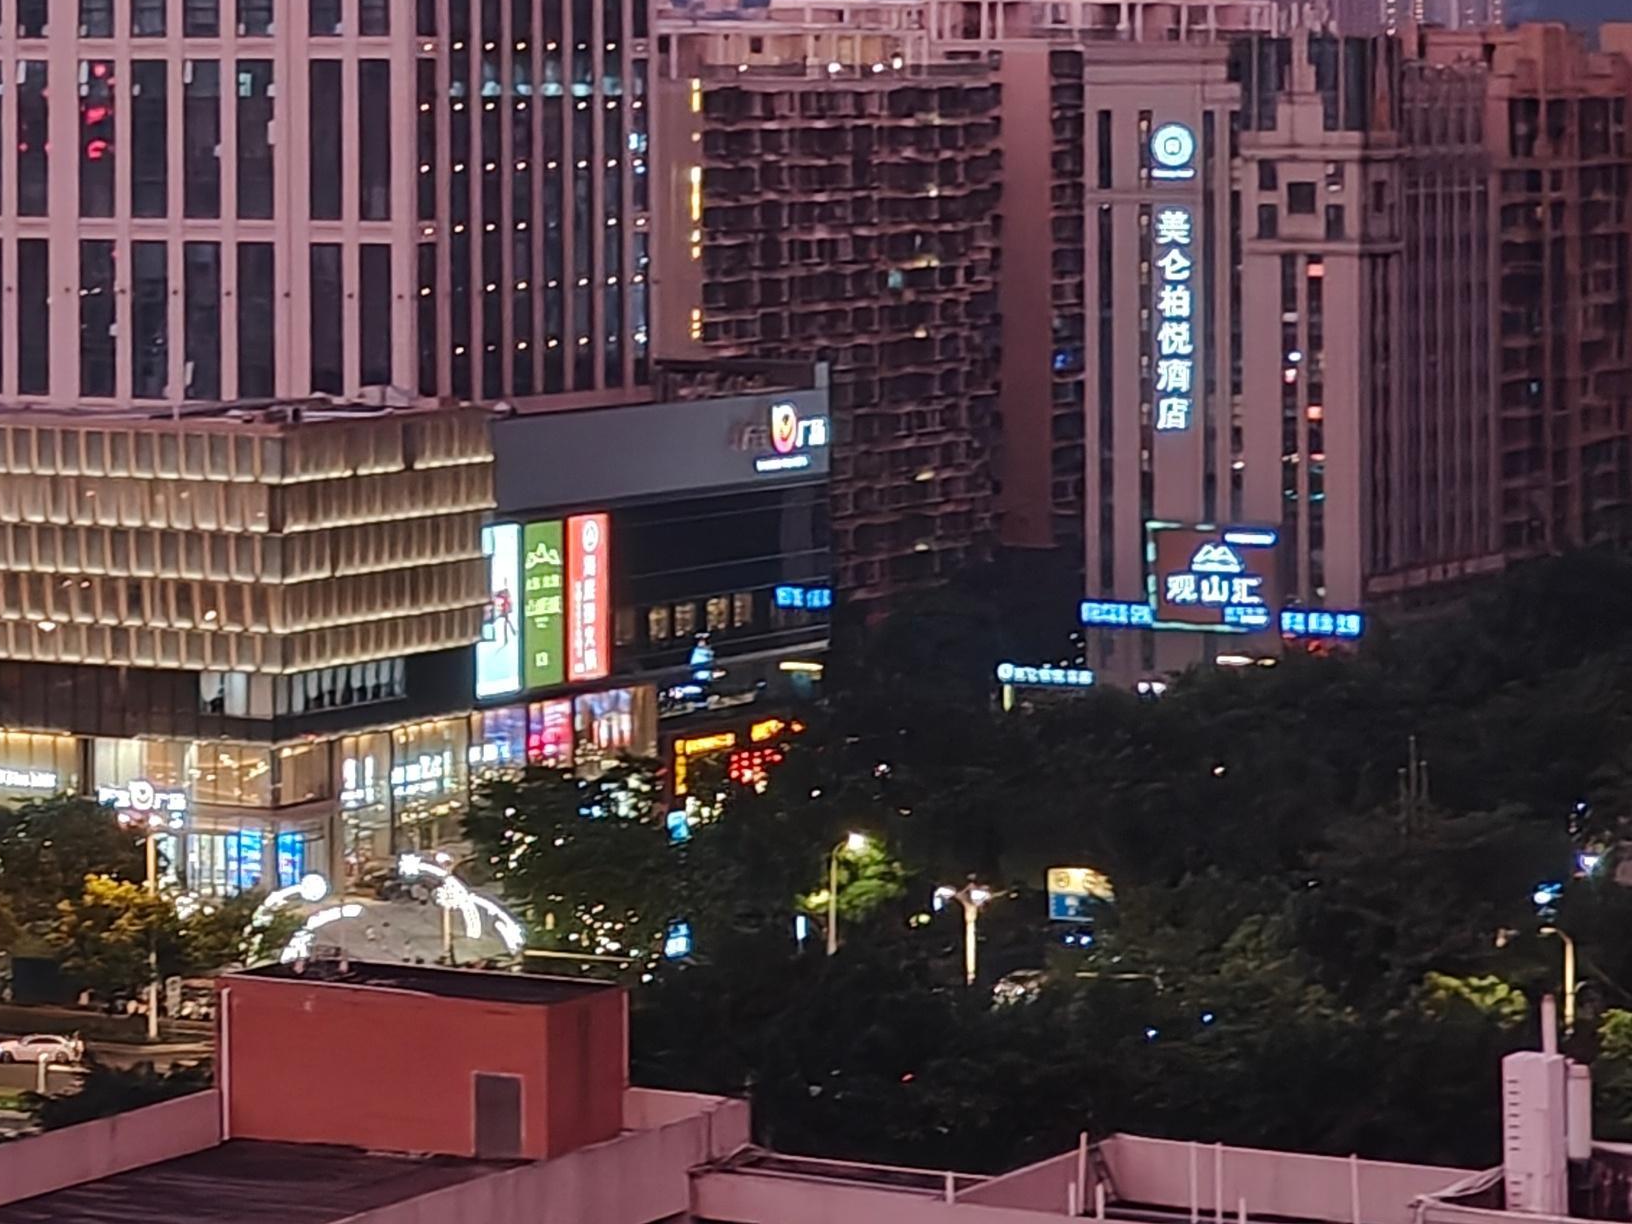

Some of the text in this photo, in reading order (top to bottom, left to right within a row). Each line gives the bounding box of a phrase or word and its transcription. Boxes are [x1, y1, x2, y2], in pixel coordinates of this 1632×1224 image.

[1155, 210, 1194, 430] 美仑柏悦酒店
[1166, 574, 1263, 604] 观山汇
